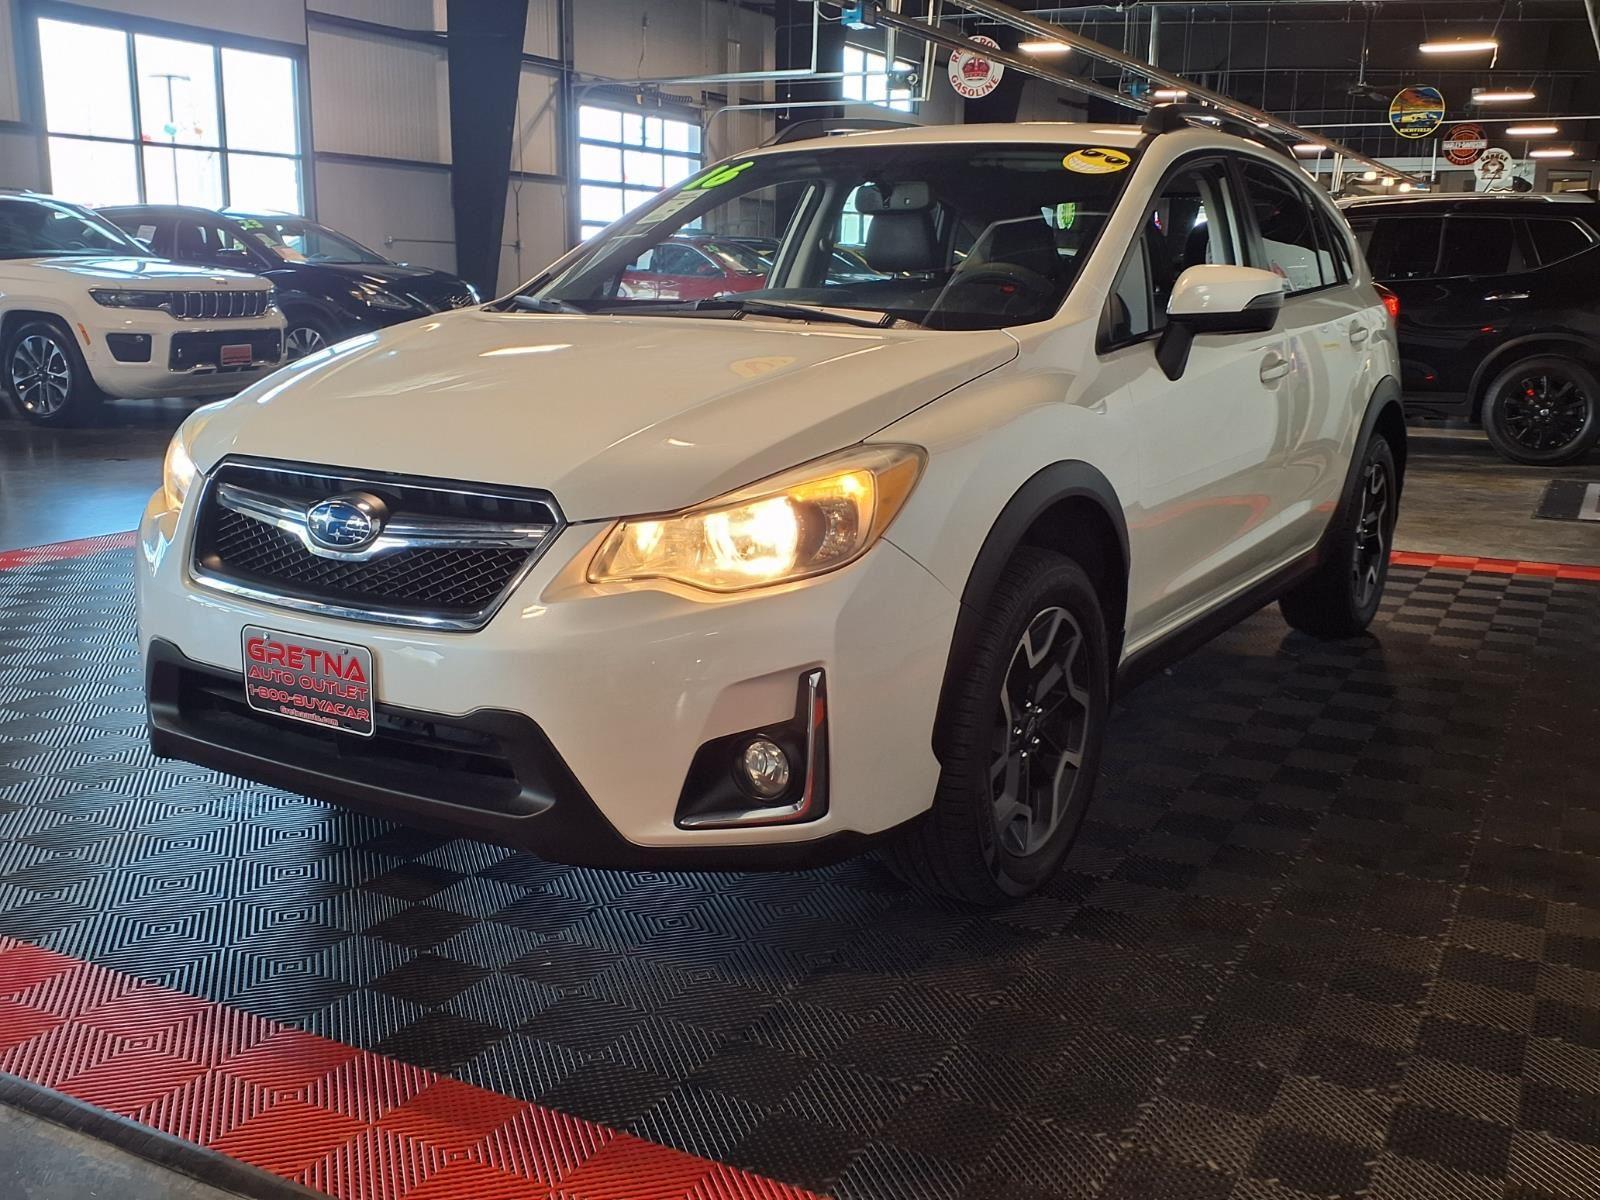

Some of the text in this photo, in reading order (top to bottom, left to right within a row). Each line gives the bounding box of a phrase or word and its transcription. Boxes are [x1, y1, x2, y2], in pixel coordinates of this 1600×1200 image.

[951, 75, 999, 97] GASOLINE
[247, 637, 367, 684] GRETNA
[248, 664, 369, 702] AUTO OUTLET
[249, 683, 370, 722] 1-800-BUYACAR
